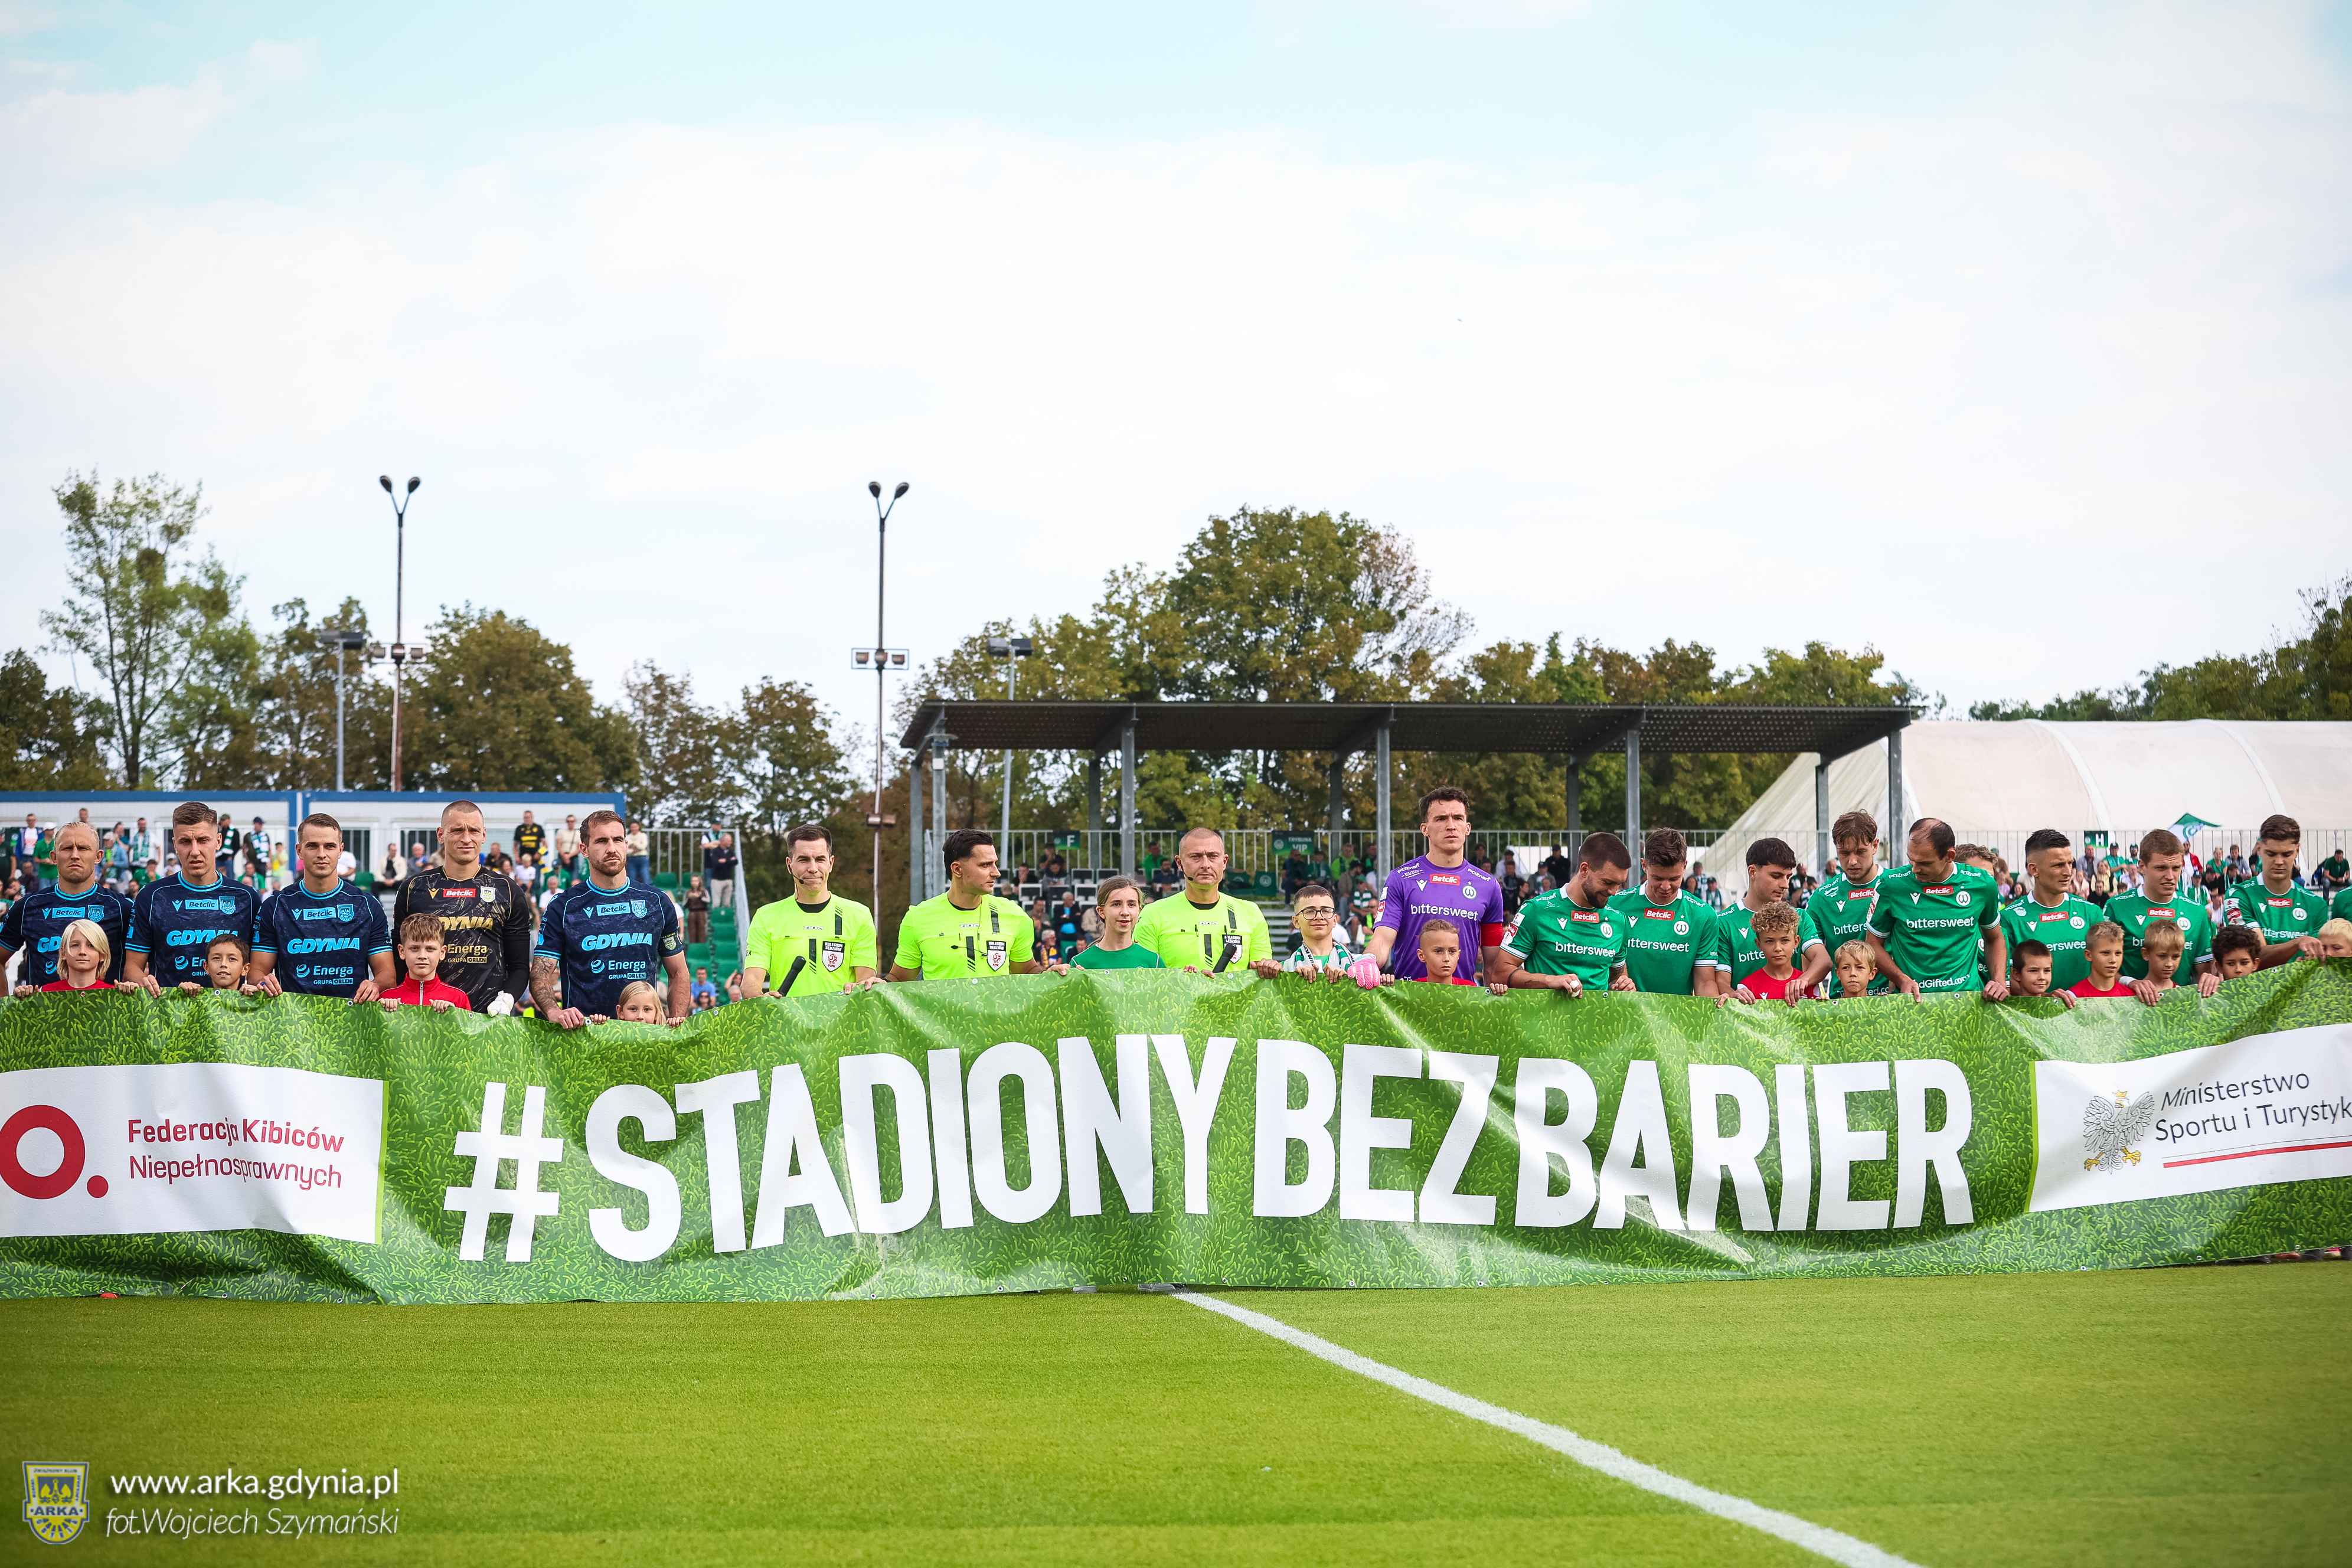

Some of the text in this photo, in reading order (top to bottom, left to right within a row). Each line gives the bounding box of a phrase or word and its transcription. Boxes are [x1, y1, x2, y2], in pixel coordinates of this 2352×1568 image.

[1067, 835, 1075, 847] F
[2095, 833, 2105, 847] H
[1432, 876, 1458, 884] Betclic
[1850, 889, 1874, 899] Betclic
[600, 905, 627, 913] Betclic
[1410, 903, 1478, 921] bittersweet
[1646, 910, 1672, 919] Betclic
[2149, 909, 2174, 917] Betclic
[437, 916, 494, 931] DYNIA
[1573, 913, 1597, 921] Betclic
[1906, 916, 1974, 929] bittersweet
[2041, 913, 2066, 922] Betclic
[1833, 923, 1868, 935] bitters
[166, 929, 239, 946] GDYN
[581, 933, 652, 951] GDYNIA
[287, 937, 360, 954] GDYNIA
[447, 943, 487, 956] Energa
[1555, 941, 1616, 958] bittersweet
[1628, 937, 1690, 952] ittersweet
[2045, 940, 2087, 952] erswee
[313, 965, 354, 978] Energa
[608, 960, 646, 972] Energa
[2161, 1072, 2309, 1111] Ministerstwo
[2155, 1115, 2236, 1143] Sportu
[2244, 1108, 2250, 1129] i
[128, 1116, 345, 1153] Federacja Kibiców
[129, 1153, 342, 1191] Niepełnosprawnych
